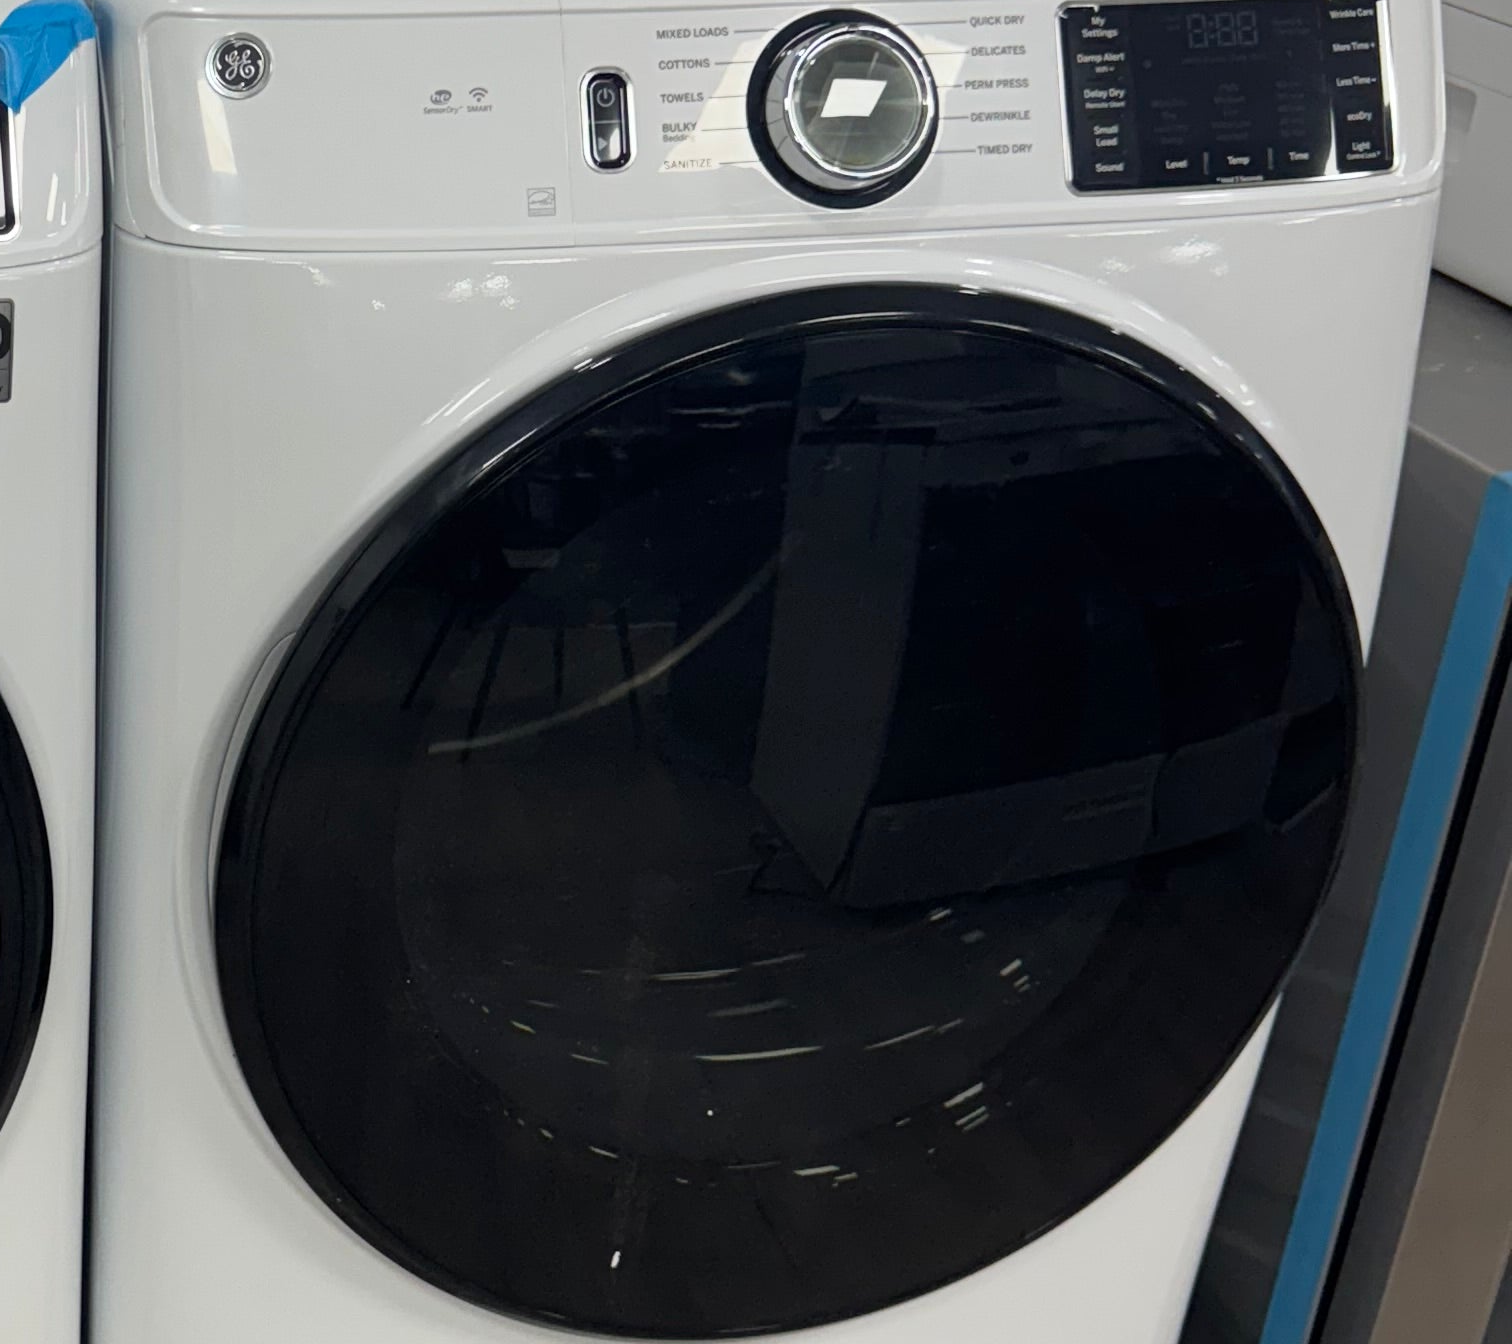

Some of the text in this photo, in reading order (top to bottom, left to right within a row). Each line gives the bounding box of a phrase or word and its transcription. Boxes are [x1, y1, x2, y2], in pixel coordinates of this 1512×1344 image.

[969, 16, 1025, 27] QUICK DRY
[656, 27, 729, 39] MIXED LOADS
[971, 45, 1026, 56] DELICATES
[658, 58, 710, 70] COTTONS
[965, 78, 1029, 89] PERM PRESS
[660, 92, 704, 103] TOWELS
[971, 110, 1031, 122] DEWRINKLE
[662, 122, 697, 133] BULKY
[977, 144, 1033, 155] TIMED DRY
[663, 158, 713, 170] SANITIZE
